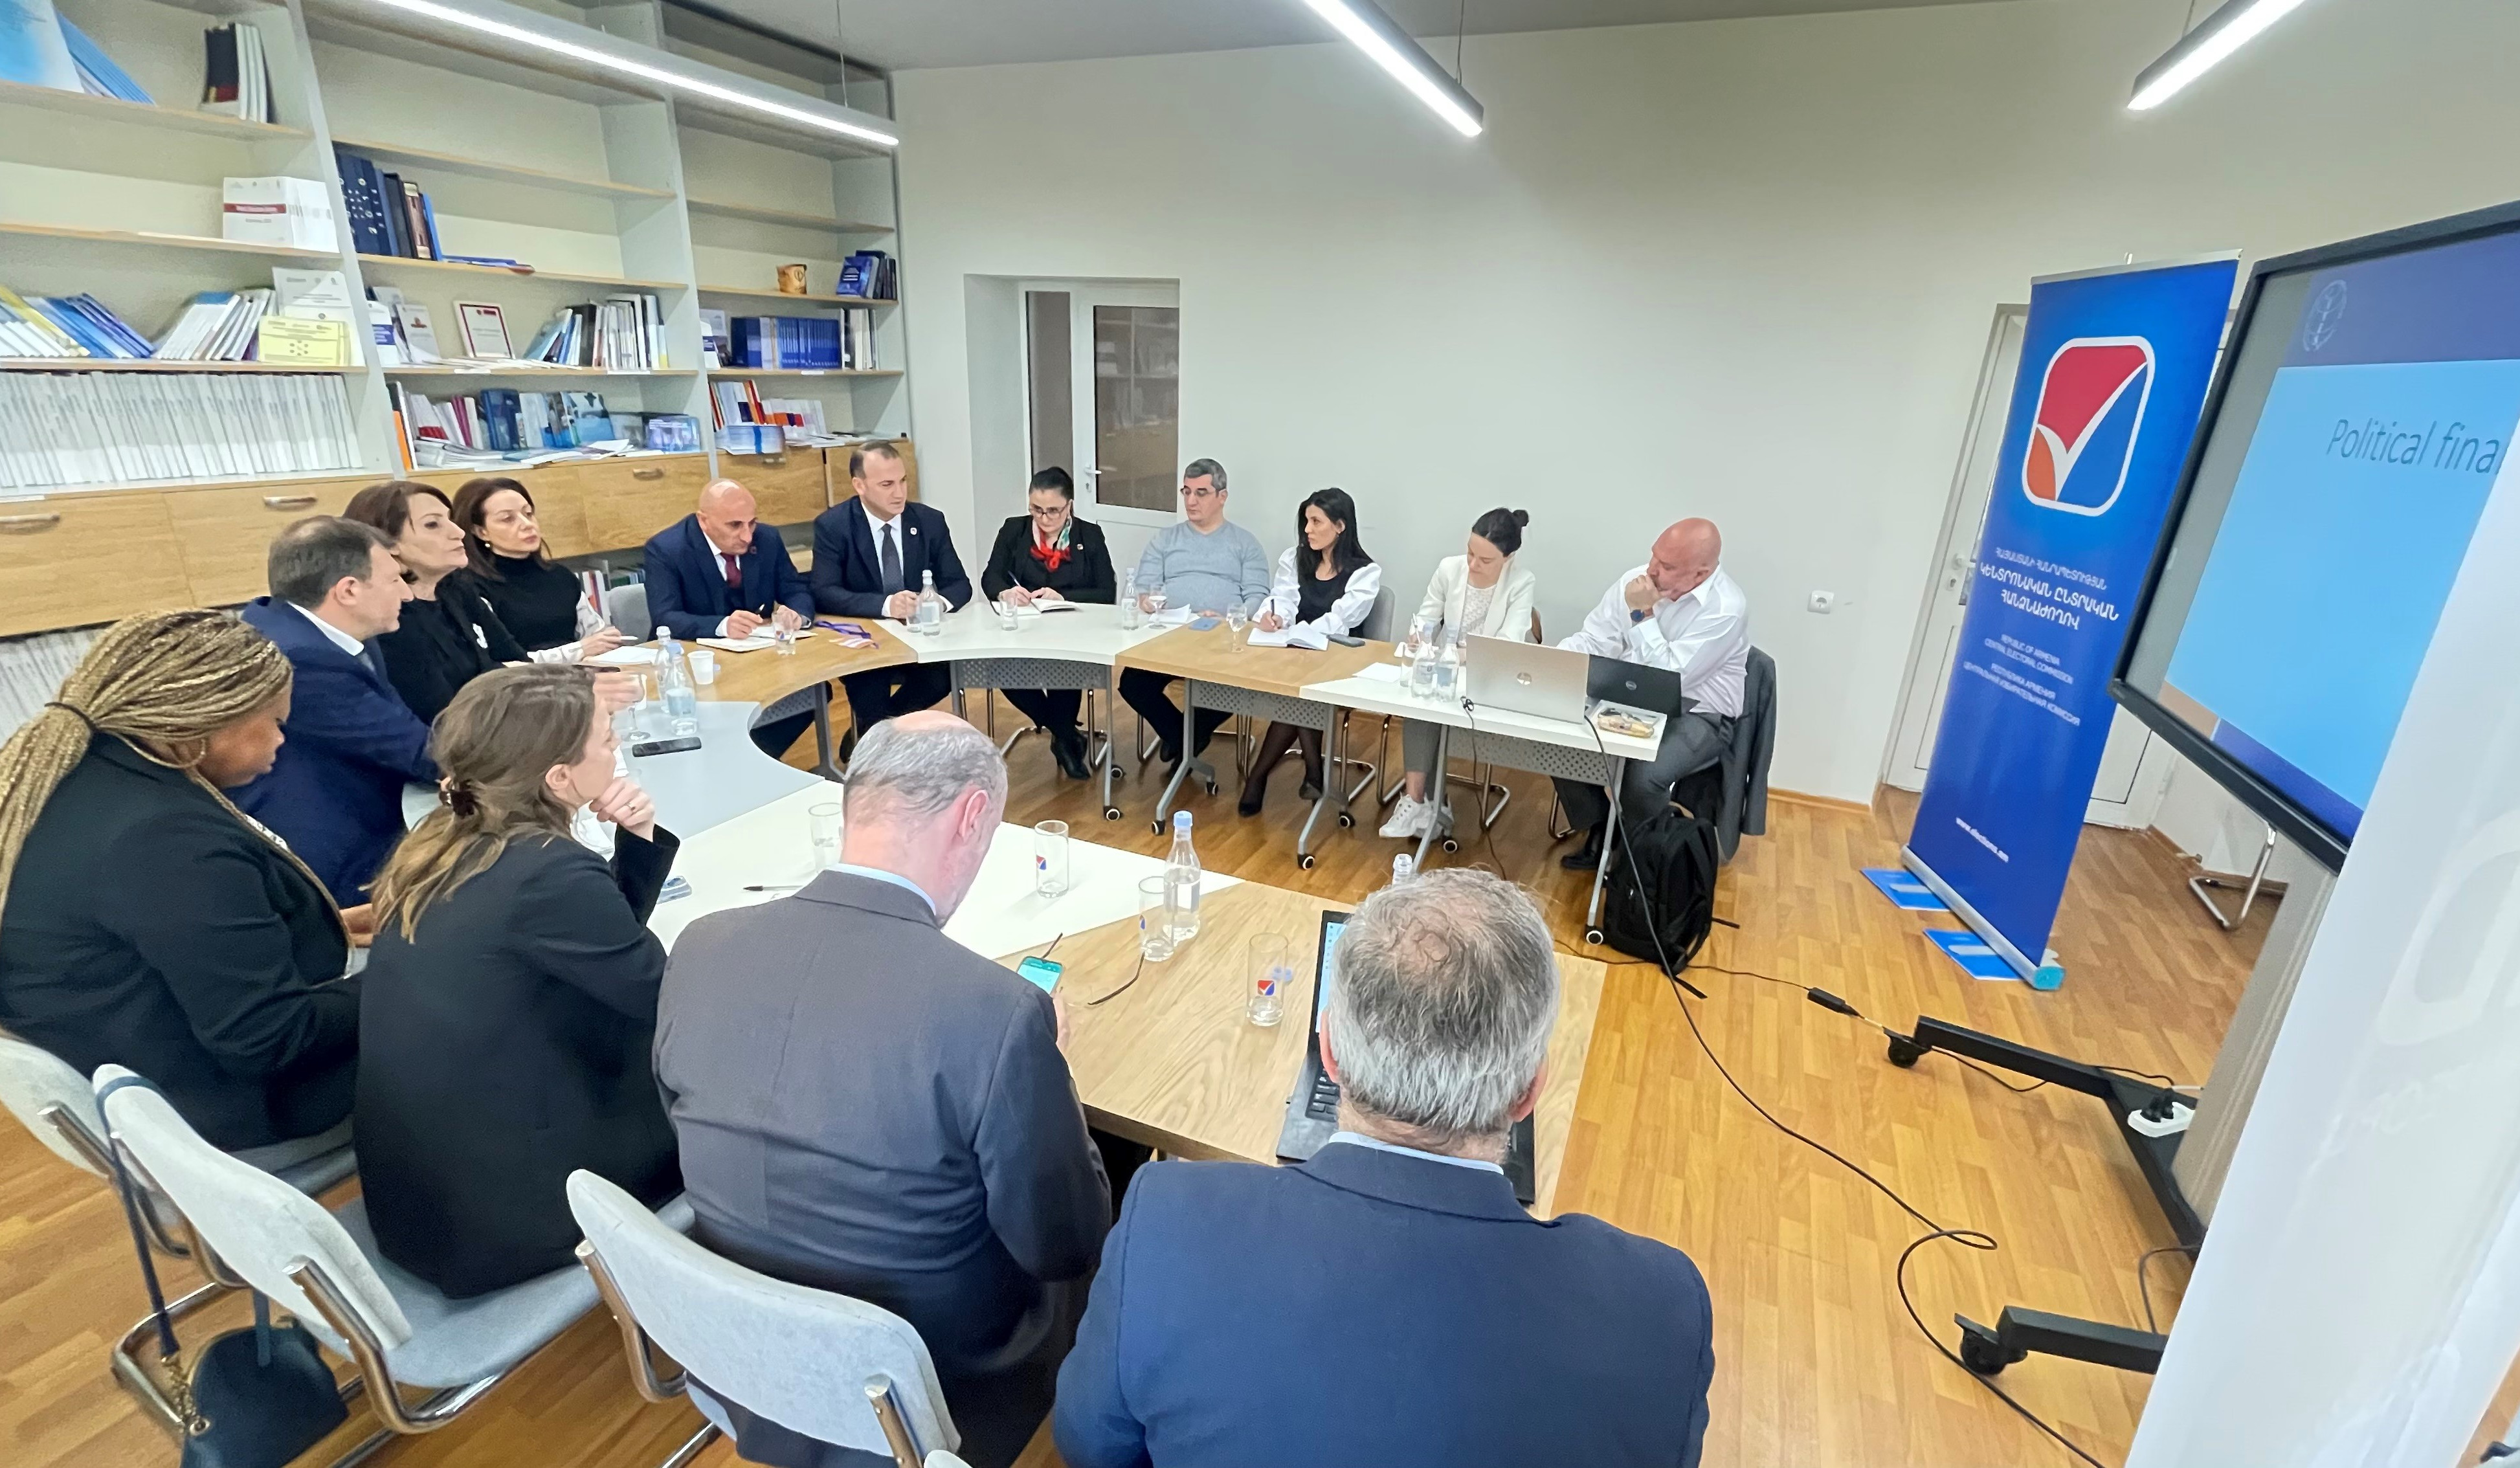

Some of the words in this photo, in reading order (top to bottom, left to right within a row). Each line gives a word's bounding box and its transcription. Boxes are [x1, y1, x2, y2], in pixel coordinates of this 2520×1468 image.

[2326, 418, 2437, 466] Political
[2434, 422, 2501, 475] fina
[1980, 562, 2052, 597] ԿԵՆՏՐՈՆԱԿԱՆ
[2054, 587, 2119, 621] ԸՆՏՐԱԿԱՆ
[2001, 589, 2080, 630] ՀԱՆՁՆԱԺՈՂՈՎ
